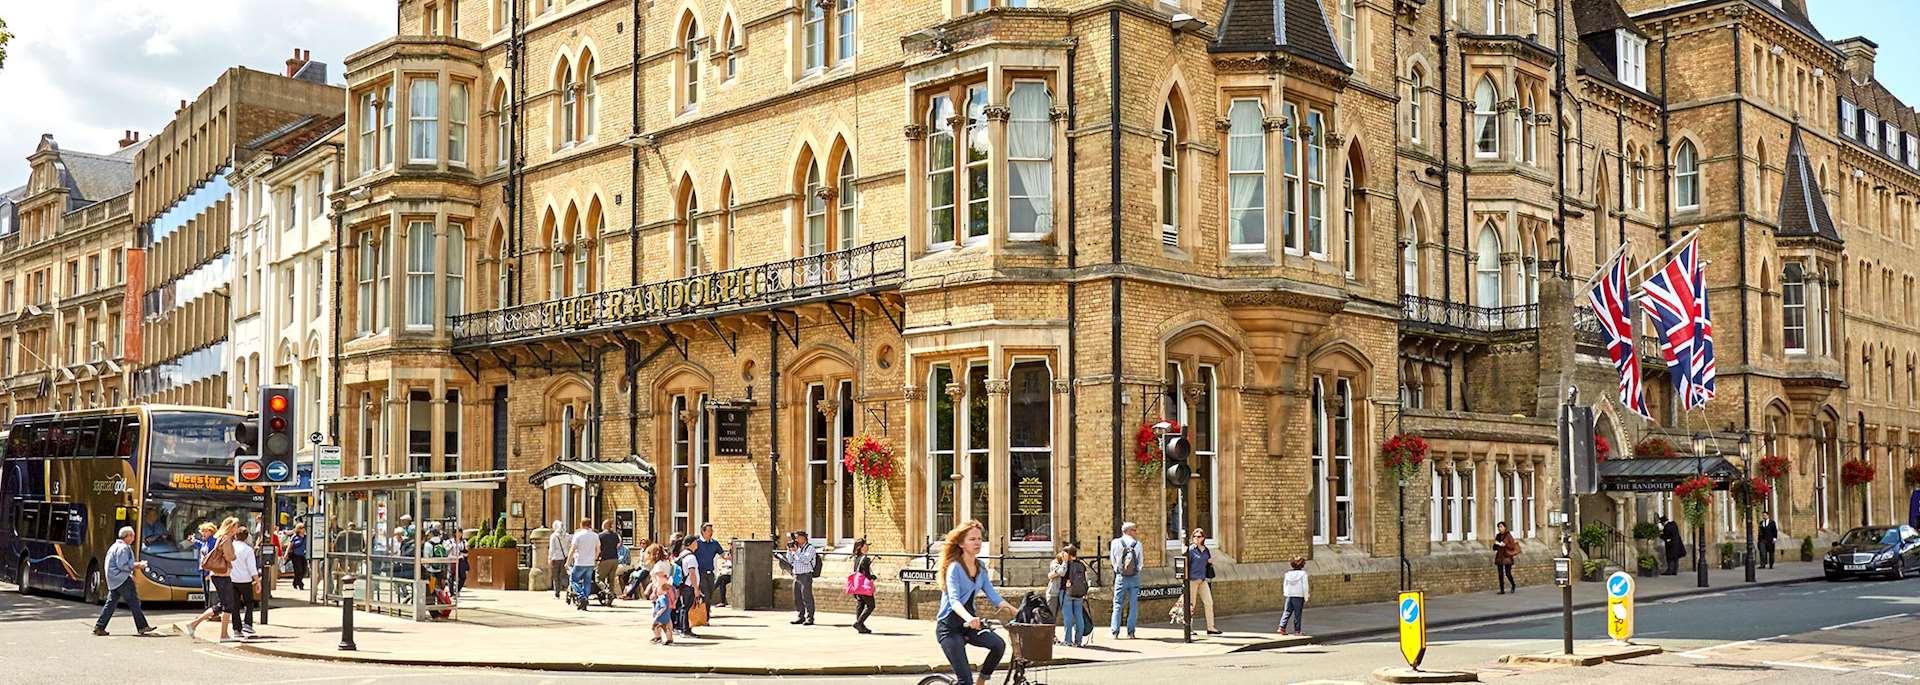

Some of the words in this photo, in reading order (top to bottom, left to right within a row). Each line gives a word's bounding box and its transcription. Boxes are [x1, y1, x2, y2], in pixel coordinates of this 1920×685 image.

[545, 297, 596, 328] THE
[607, 267, 760, 320] RANDOLPH
[902, 571, 934, 579] MAGDALEN
